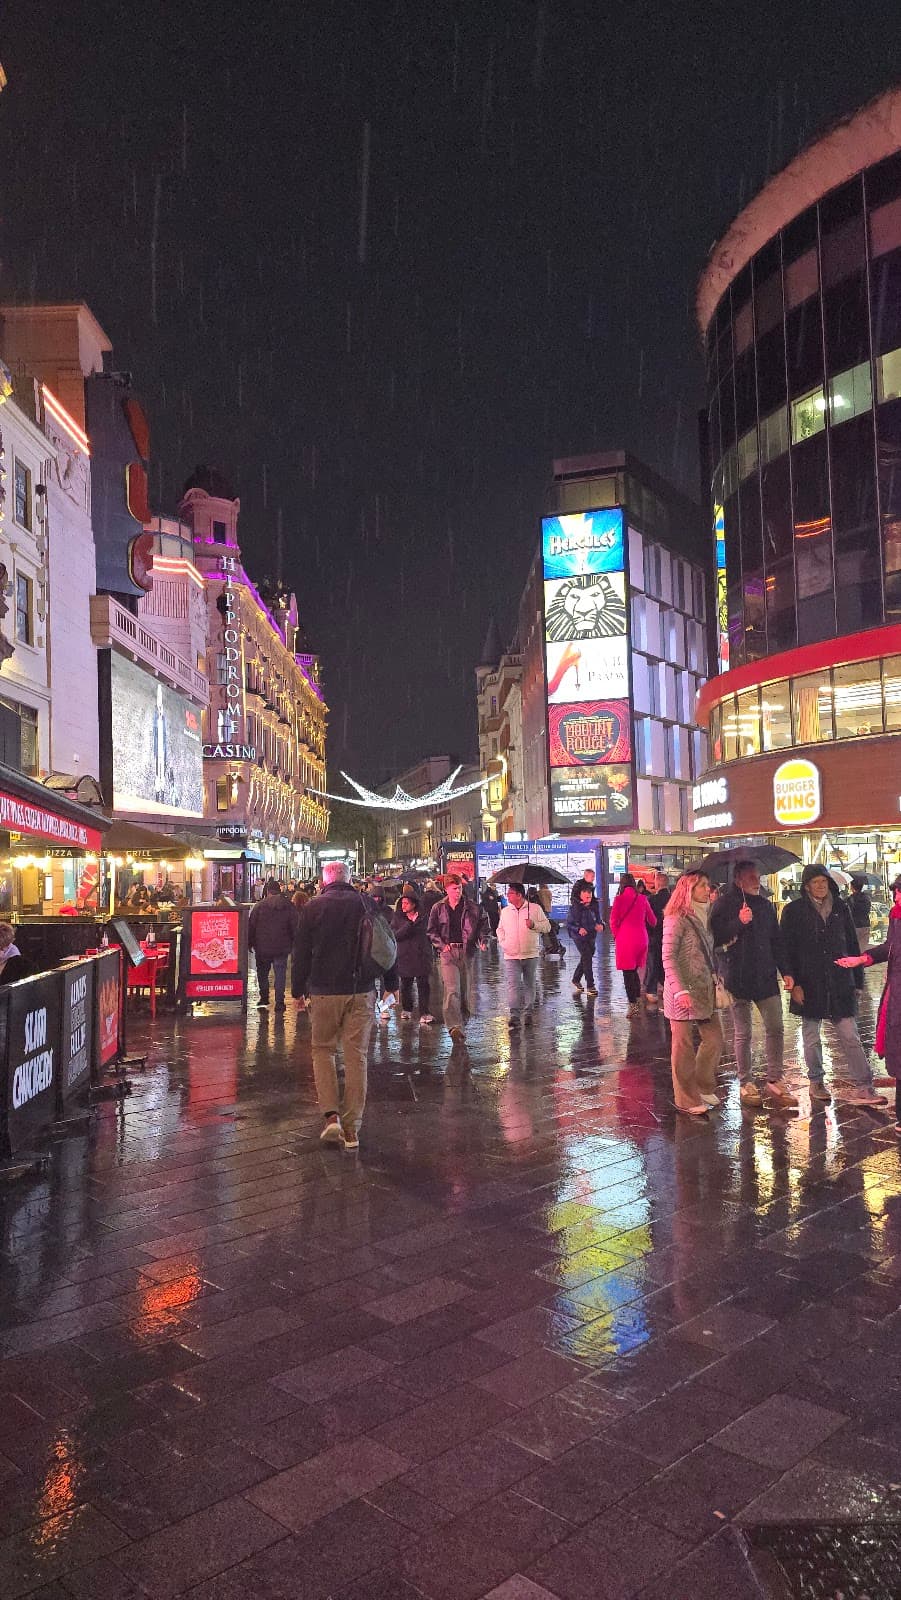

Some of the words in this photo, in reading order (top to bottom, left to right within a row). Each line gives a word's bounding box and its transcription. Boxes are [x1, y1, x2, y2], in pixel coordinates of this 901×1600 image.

[550, 528, 616, 556] HERCULES
[221, 556, 242, 734] HIPPODROME
[566, 721, 607, 738] MOULIN
[202, 744, 256, 759] CASINO
[776, 780, 815, 793] BURGER
[555, 799, 607, 812] HADESTOWN
[777, 792, 815, 810] KING
[24, 1006, 47, 1055] SLIM
[13, 1048, 54, 1110] CHICKENS
